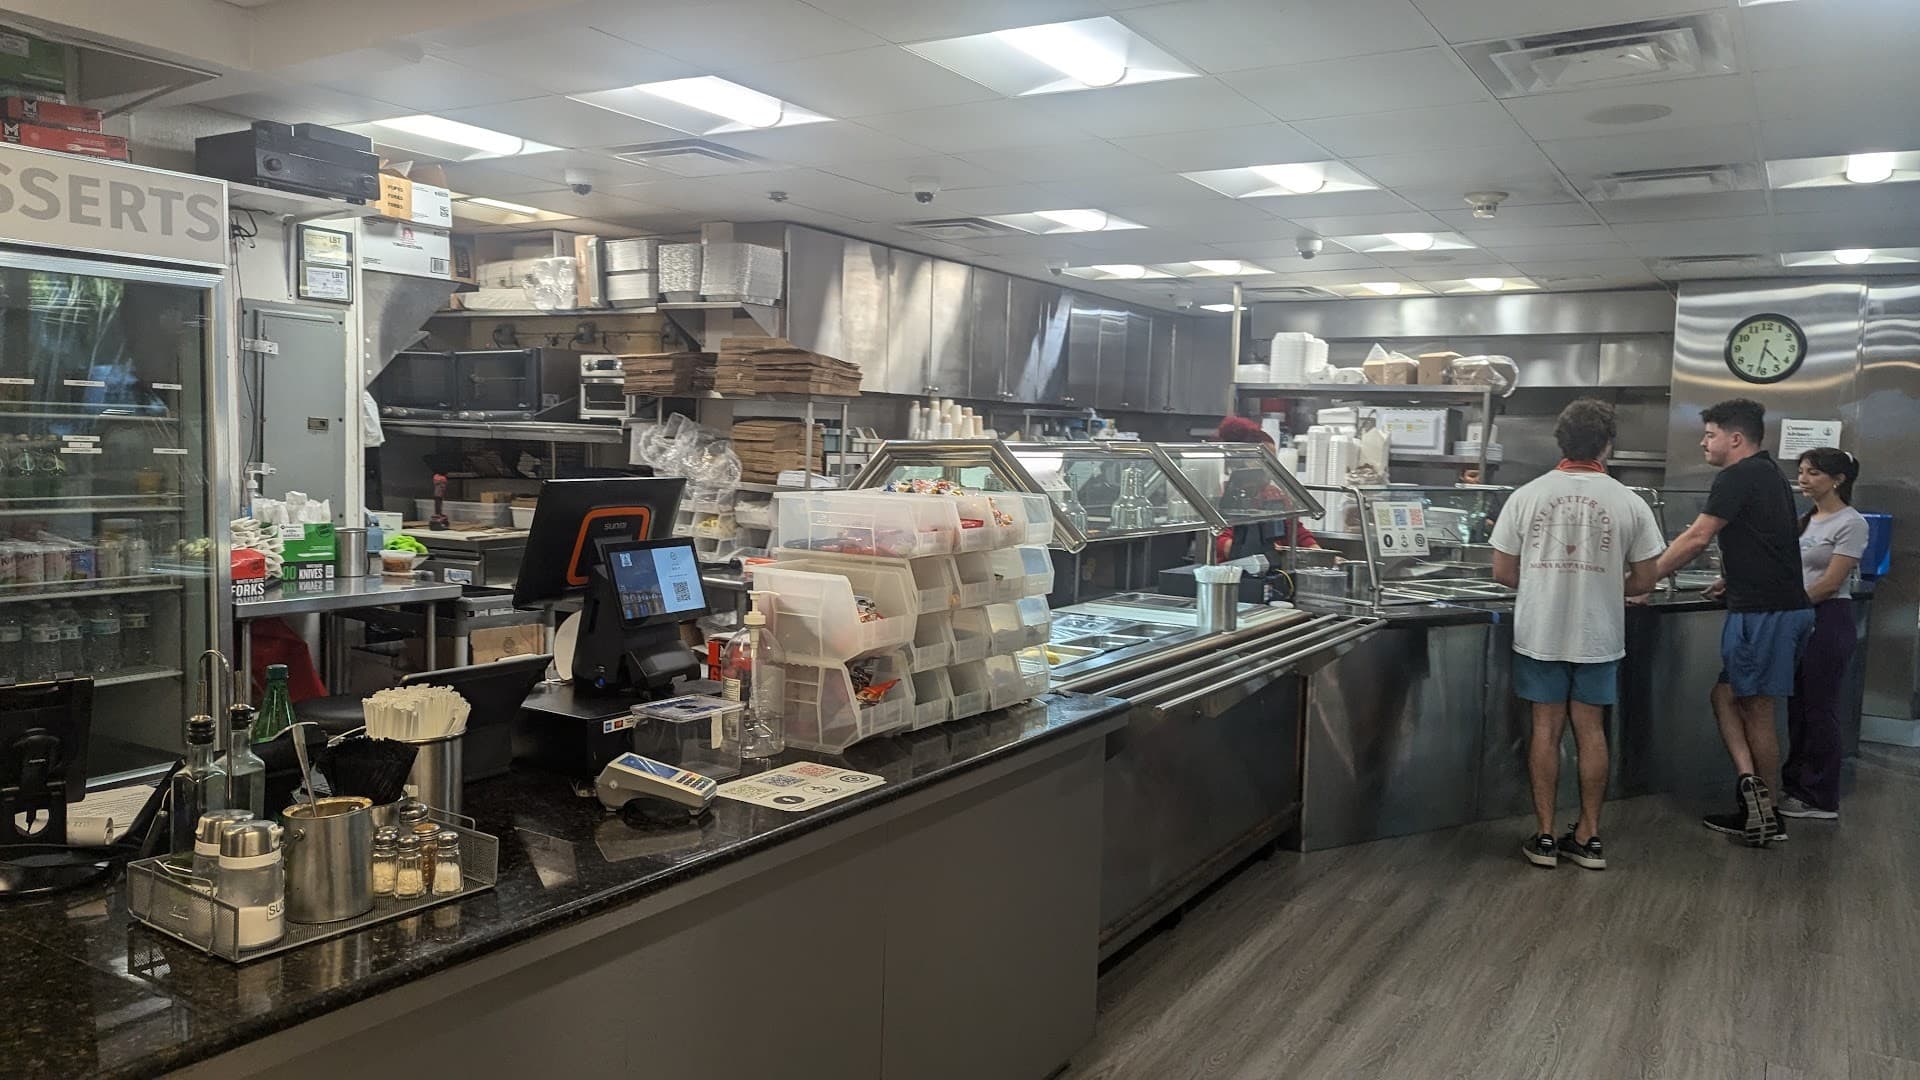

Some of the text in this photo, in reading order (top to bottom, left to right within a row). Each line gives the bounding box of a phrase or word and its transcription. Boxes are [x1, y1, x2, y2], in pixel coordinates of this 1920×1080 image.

[1749, 326, 1759, 334] 11
[1761, 322, 1774, 331] 12
[1740, 334, 1750, 342] 10
[1532, 511, 1548, 539] LOVE
[1549, 495, 1598, 509] LETTER
[1600, 529, 1612, 553] YOU
[298, 568, 324, 580] KNIVES
[231, 582, 265, 597] FORKS
